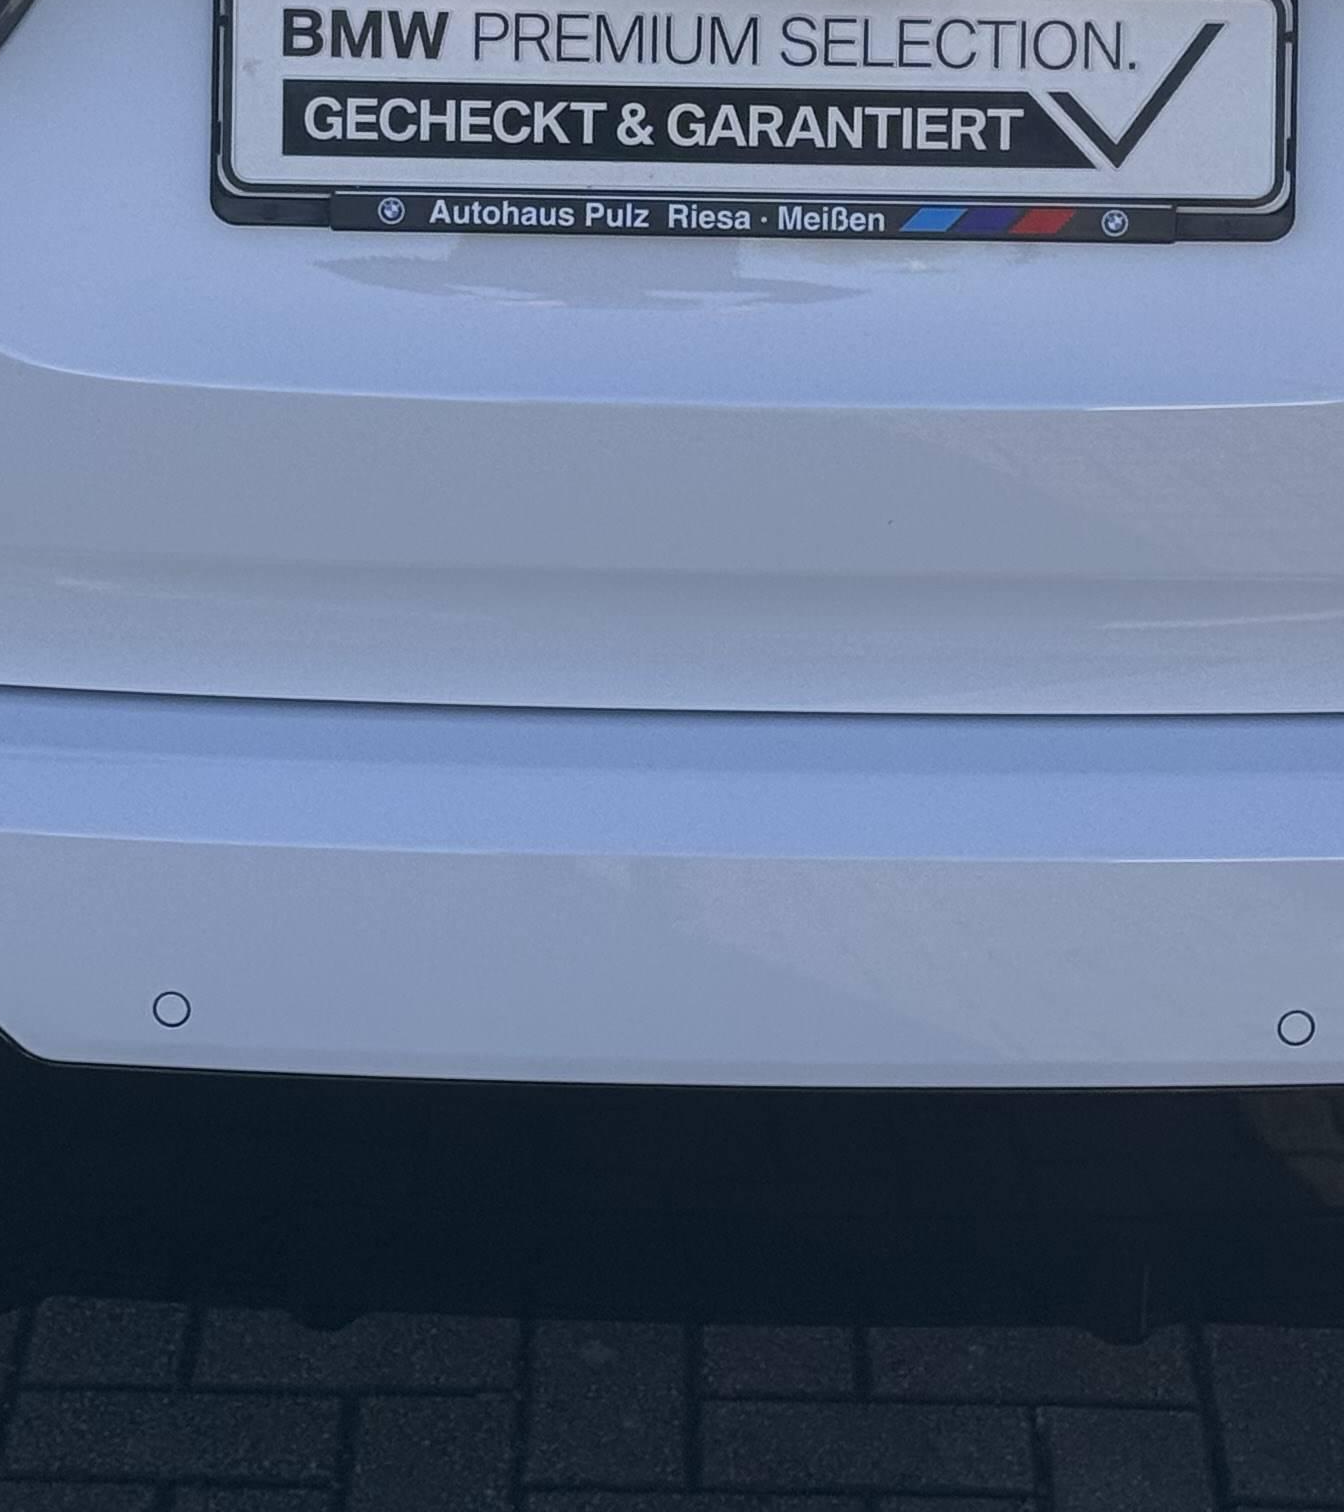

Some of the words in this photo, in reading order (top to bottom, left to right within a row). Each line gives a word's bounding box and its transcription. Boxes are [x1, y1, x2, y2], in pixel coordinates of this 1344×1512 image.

[282, 8, 450, 60] BMW
[473, 11, 759, 66] PREMIUM
[780, 14, 1138, 71] SELECTION.
[303, 95, 608, 145] GECHECKT
[615, 101, 655, 146] &
[666, 102, 1025, 152] GARANTIERT
[429, 199, 575, 226] Autohaus
[585, 202, 650, 228] Pulz
[668, 203, 752, 230] Riesa
[777, 205, 886, 232] Meißen
